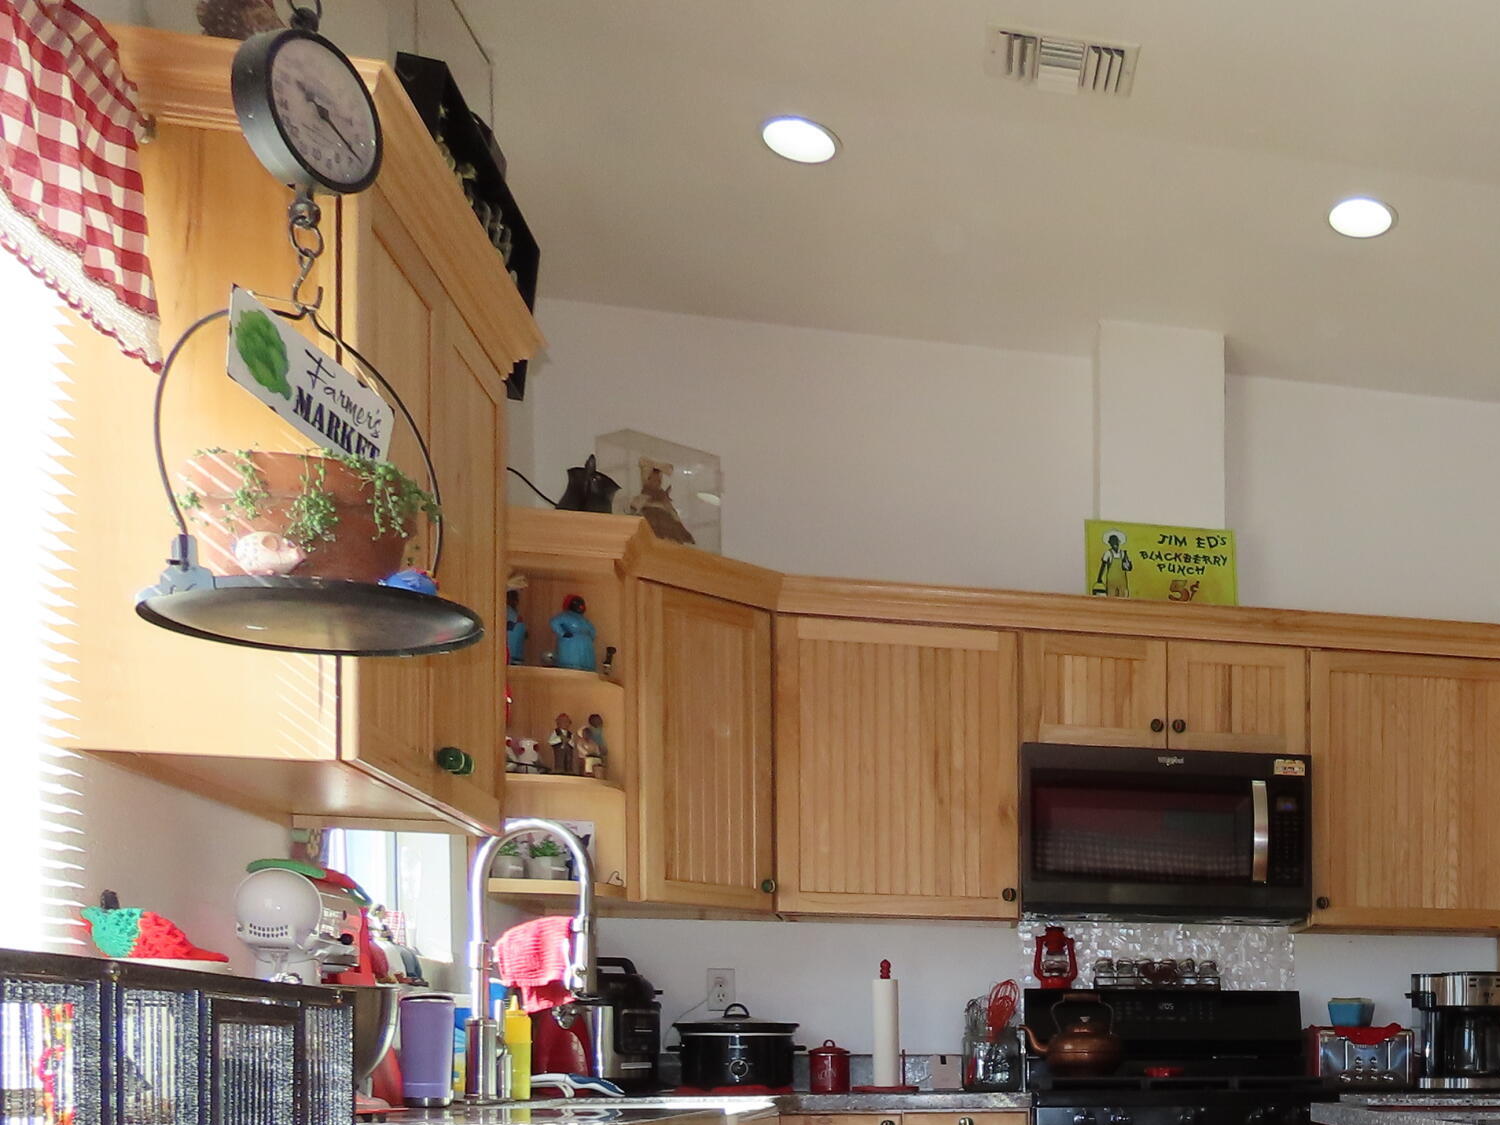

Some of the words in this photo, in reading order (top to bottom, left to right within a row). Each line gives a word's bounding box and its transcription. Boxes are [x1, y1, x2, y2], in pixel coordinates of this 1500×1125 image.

[304, 349, 382, 438] Farmer's
[1157, 534, 1187, 547] JIM
[1139, 550, 1228, 566] BLACKBERRY
[1157, 563, 1206, 576] PUNCH
[1168, 580, 1200, 602] 5¢
